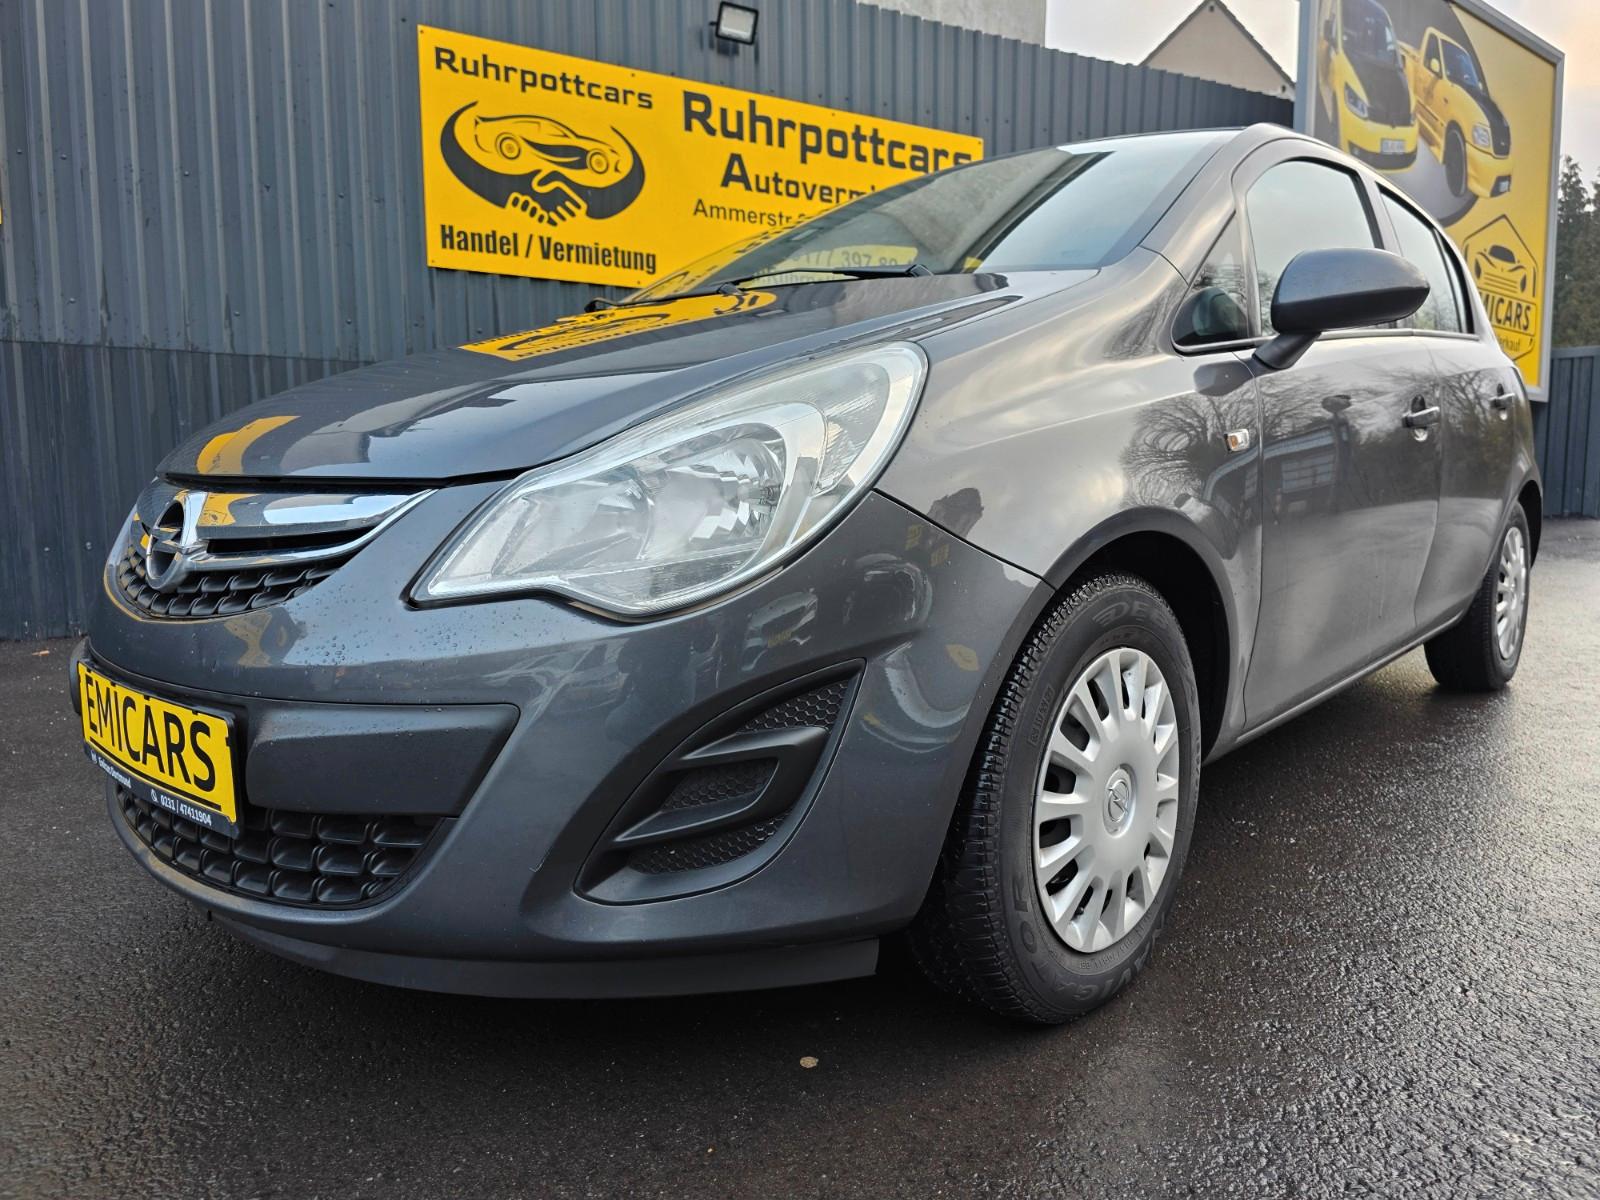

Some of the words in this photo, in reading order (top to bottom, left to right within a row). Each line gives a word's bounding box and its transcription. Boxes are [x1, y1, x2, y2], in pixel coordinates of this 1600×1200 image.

[435, 46, 653, 110] Ruhrpottcars
[721, 153, 876, 205] Autover
[440, 224, 518, 257] Handel
[539, 235, 657, 276] Vermietung
[1479, 291, 1531, 332] MICARS
[85, 673, 216, 793] EMICARS
[160, 794, 176, 811] 0231
